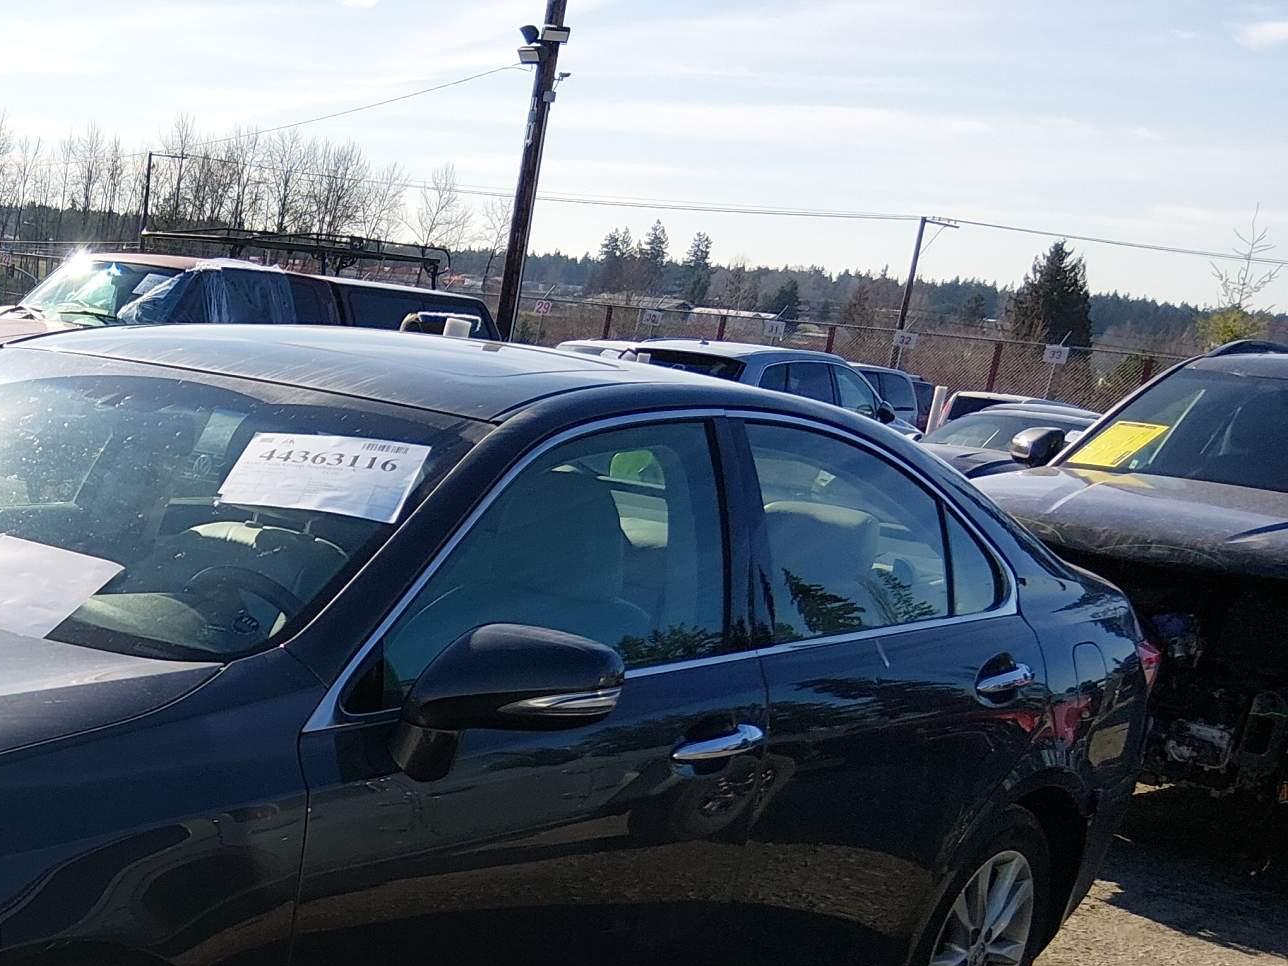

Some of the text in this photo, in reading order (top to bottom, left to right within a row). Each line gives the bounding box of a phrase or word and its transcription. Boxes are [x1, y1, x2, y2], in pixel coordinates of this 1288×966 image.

[536, 301, 550, 314] 29
[899, 335, 913, 345] 32
[259, 448, 400, 473] 44363116
